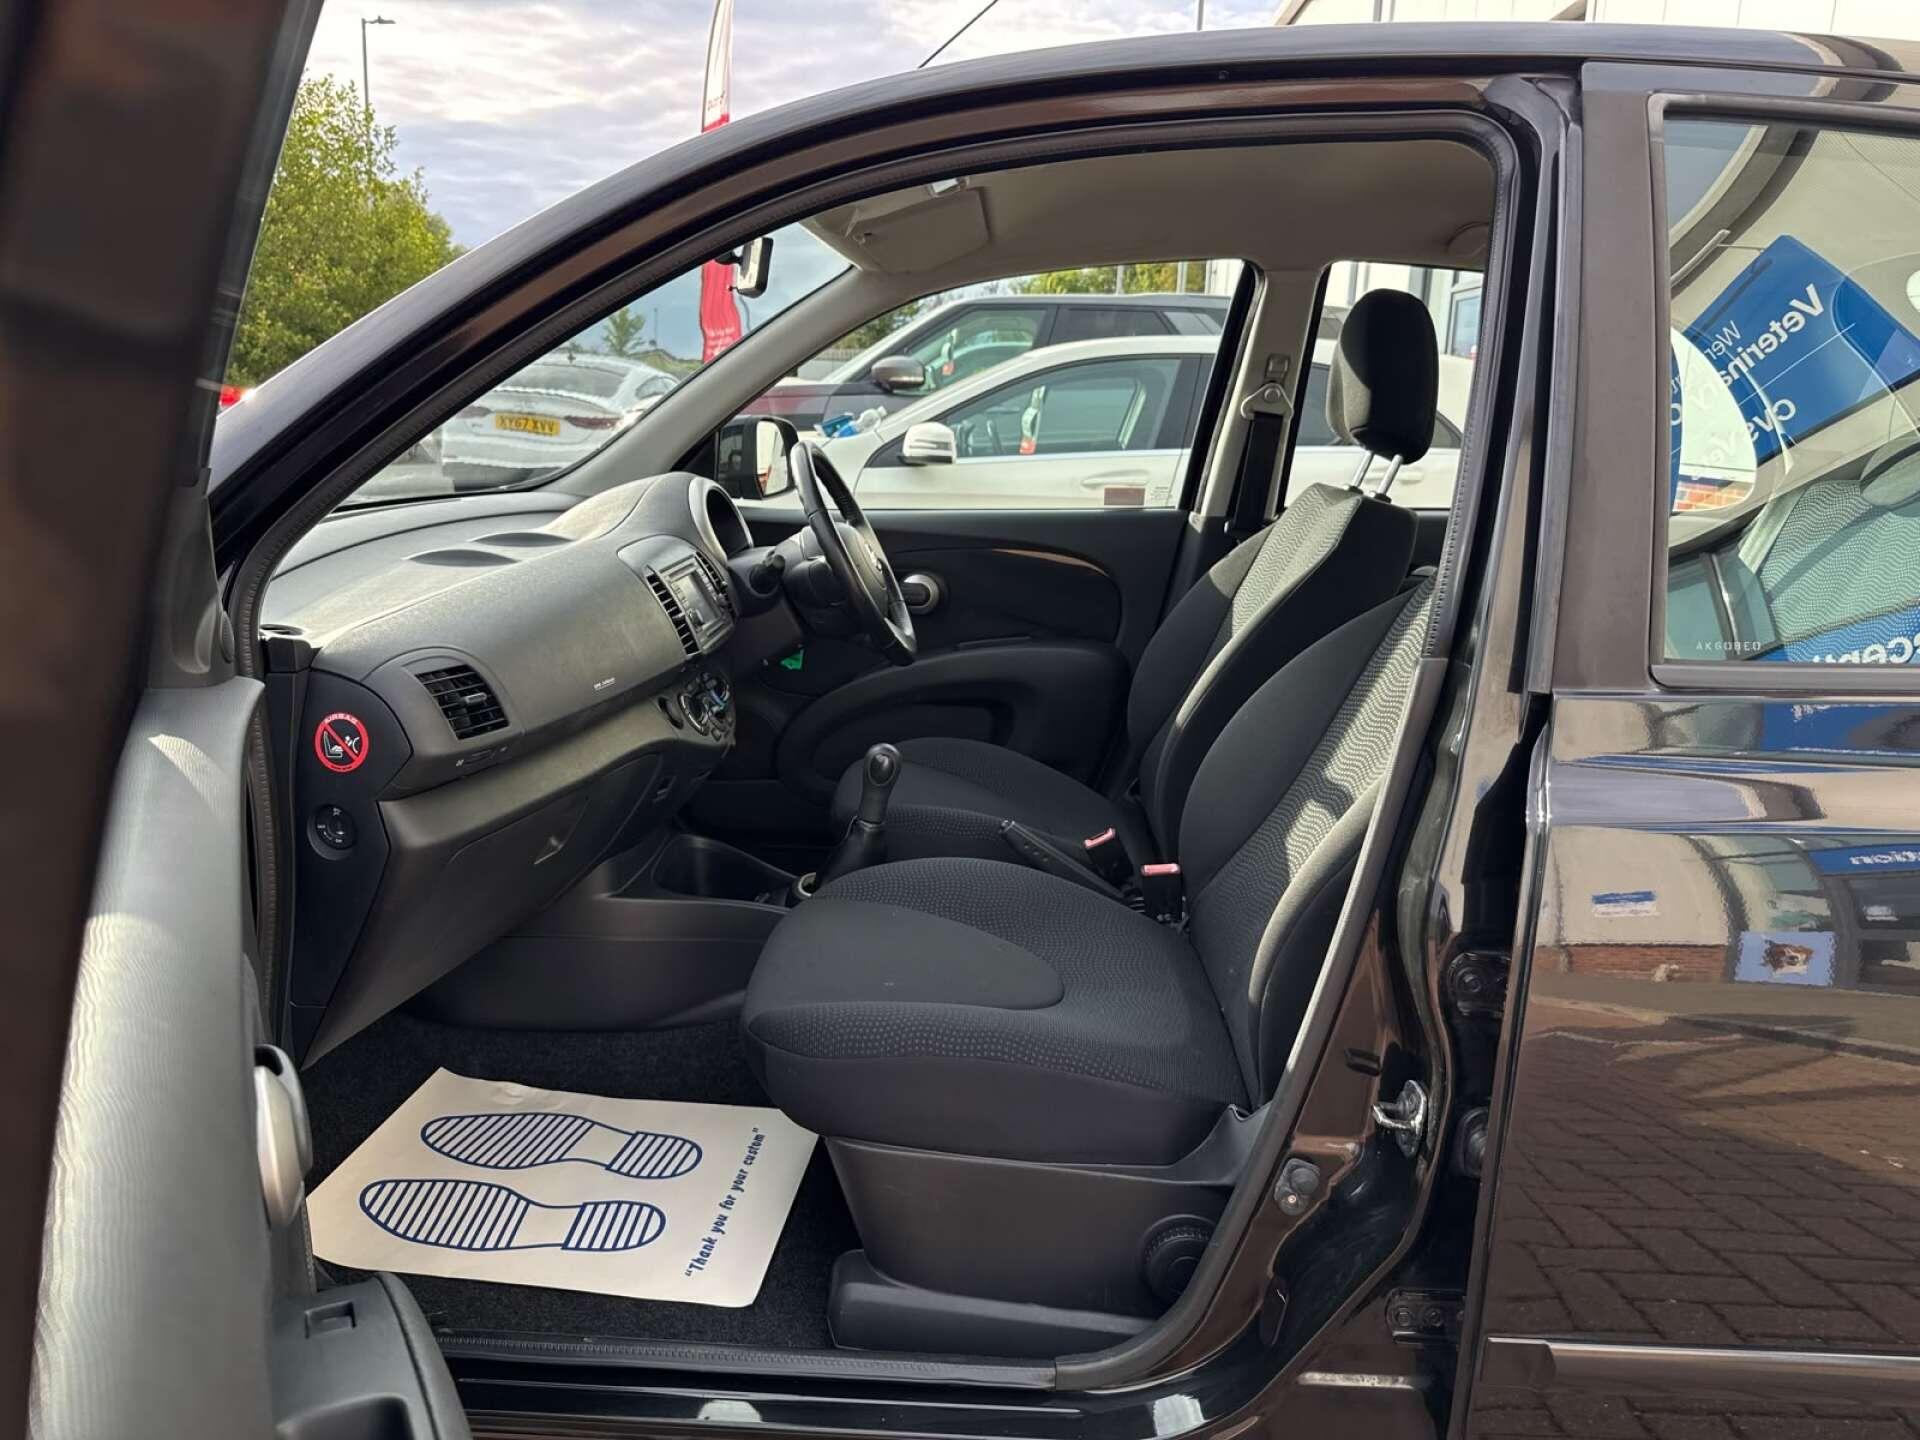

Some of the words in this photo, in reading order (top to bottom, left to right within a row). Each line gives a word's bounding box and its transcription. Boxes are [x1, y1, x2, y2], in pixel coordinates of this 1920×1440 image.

[731, 1168, 749, 1193] your
[719, 1194, 737, 1211] for
[711, 1214, 728, 1235] you
